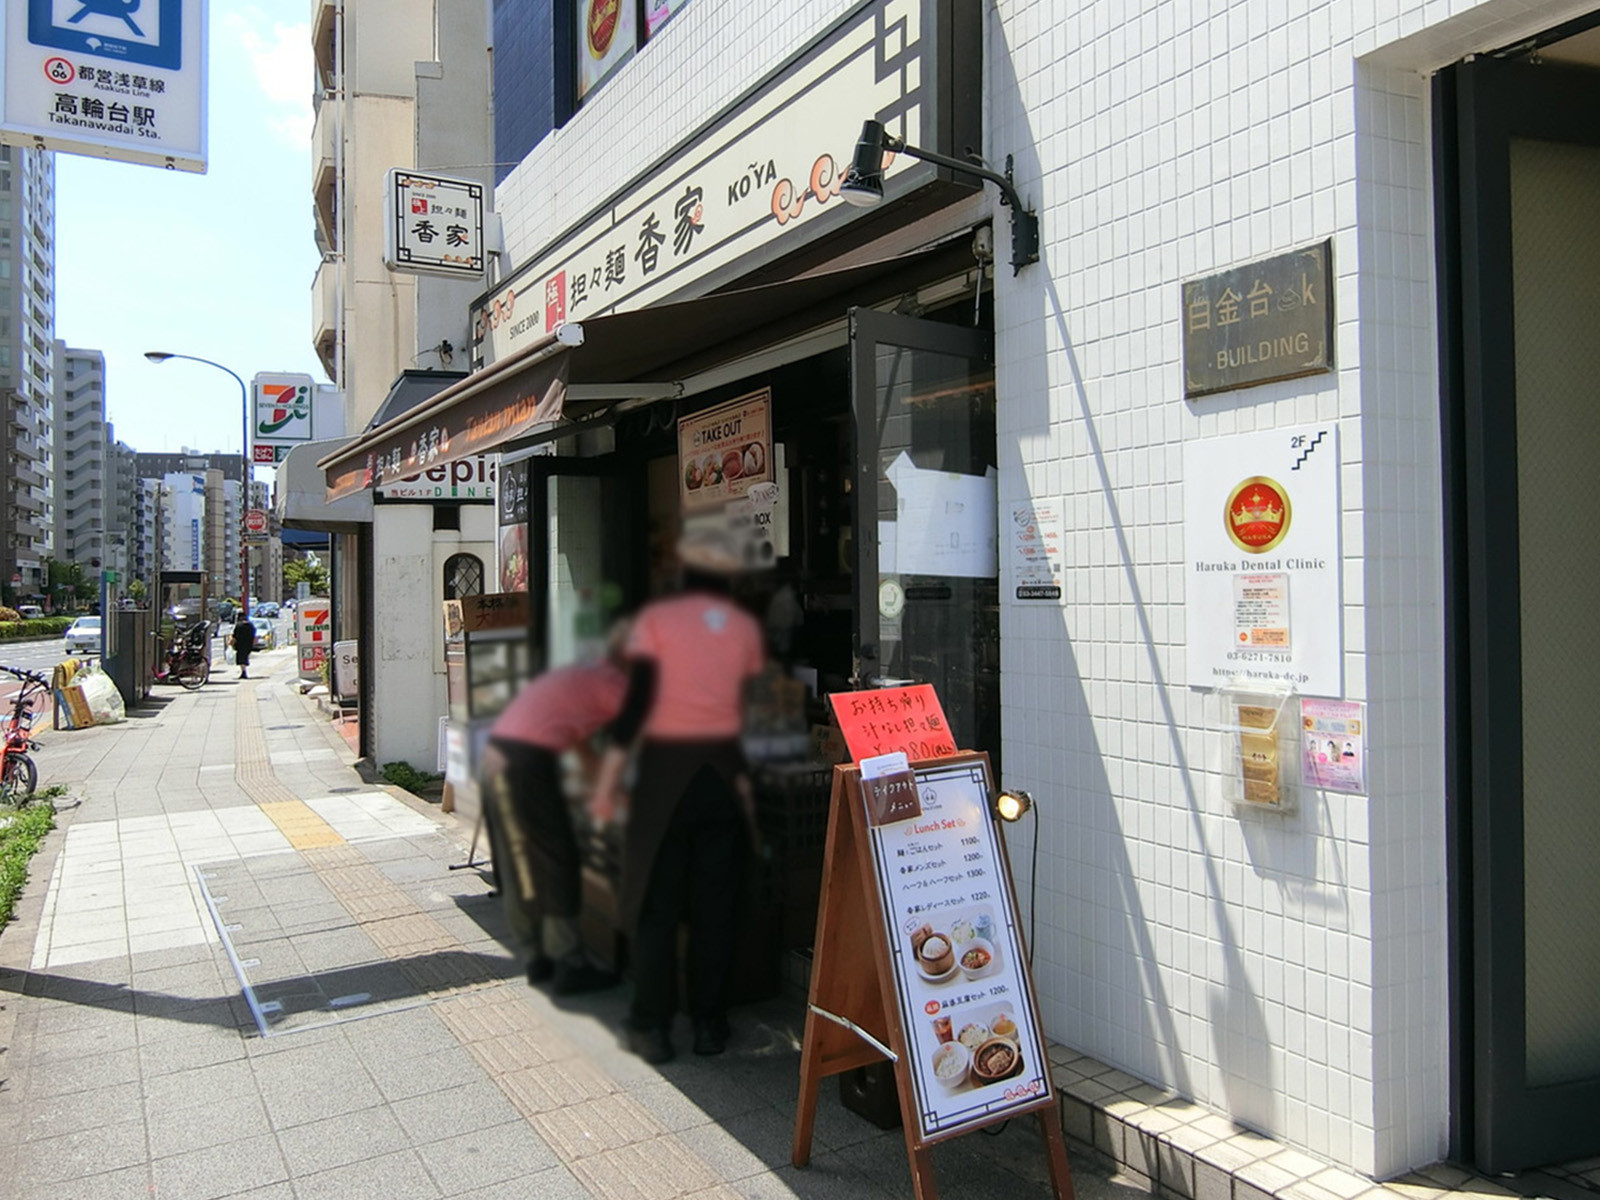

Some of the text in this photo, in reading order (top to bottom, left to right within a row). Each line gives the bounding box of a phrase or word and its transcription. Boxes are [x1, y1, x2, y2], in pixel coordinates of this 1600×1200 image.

[52, 69, 67, 79] 06
[79, 65, 165, 93] 都営浅草線
[94, 82, 150, 98] Asakusa Line
[55, 93, 155, 127] 高輪台駅
[48, 112, 161, 139] Takanawadai Sta.
[411, 220, 469, 247] 香家
[570, 186, 705, 312] 担々麺 香家
[510, 311, 539, 339] SINCE 2000
[1217, 332, 1310, 369] BUILDING
[702, 425, 722, 444] TAKE
[723, 420, 742, 437] OUT
[1291, 435, 1306, 448] 2F
[1196, 558, 1326, 572] Haruka Dental Clinic
[1226, 652, 1293, 664] 03-6271-7810
[1212, 667, 1310, 683] https://haruka-dc.jp
[851, 692, 926, 716] お持ち帰り
[914, 818, 956, 834] Lunch Set
